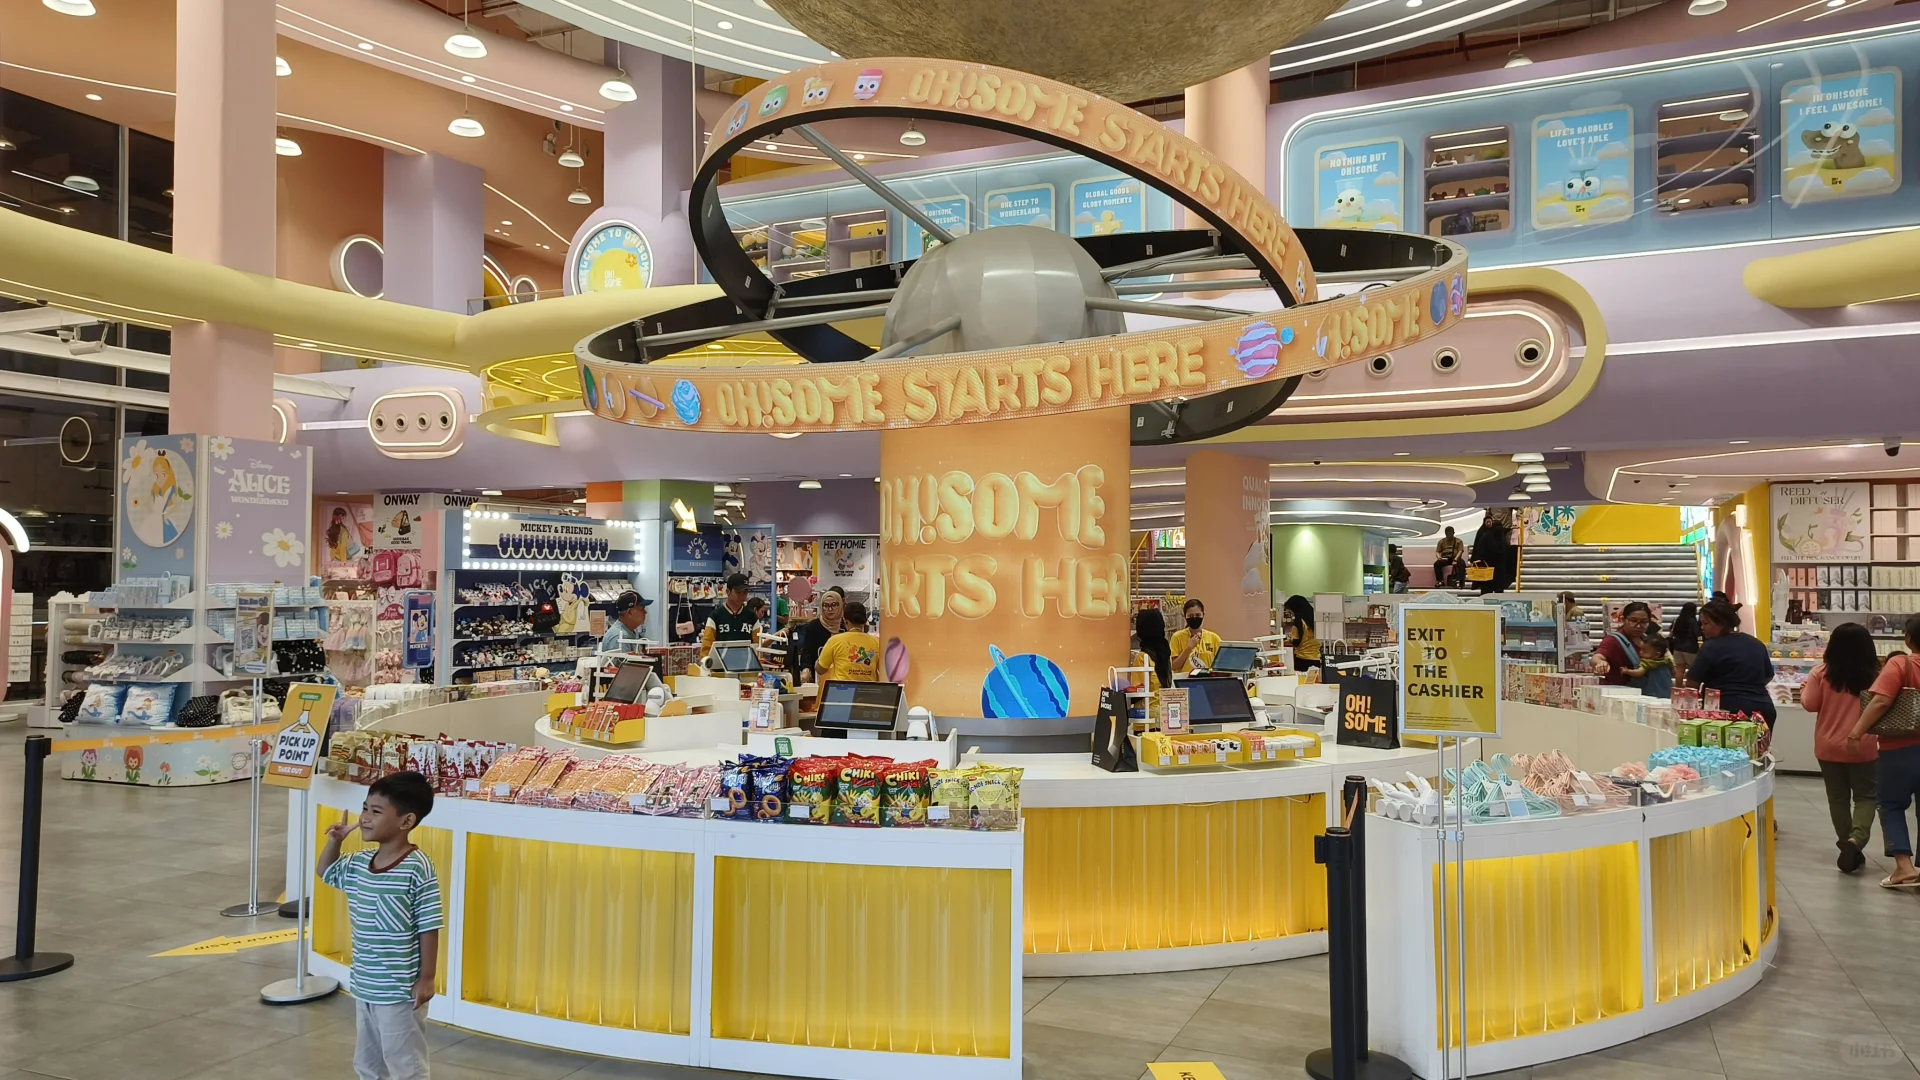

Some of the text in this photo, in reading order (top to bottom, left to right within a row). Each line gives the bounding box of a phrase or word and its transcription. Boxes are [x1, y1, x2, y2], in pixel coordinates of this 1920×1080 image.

[1813, 88, 1868, 102] IN OH!SOME
[1806, 105, 1828, 115] FEEL
[1832, 98, 1882, 112] AWESOME!
[1550, 128, 1574, 138] LIFE'S
[1557, 134, 1608, 147] LOVE'S ABLE
[1329, 152, 1387, 168] NOTHING BUT
[907, 68, 1290, 271] OH!SOME STARTS HERE
[1341, 164, 1378, 176] OH!SOME
[1110, 187, 1129, 195] GOODS
[1014, 199, 1029, 207] STEP
[1103, 197, 1132, 206] MOMENTS
[1000, 207, 1040, 218] WONDERLAND
[579, 233, 606, 287] WELCOME
[609, 228, 622, 239] TO
[716, 338, 1207, 428] OH!SOME STARTS HERE
[228, 468, 291, 495] ALICE
[1780, 486, 1811, 496] REED
[231, 496, 289, 506] WONDERLAND
[383, 494, 421, 507] ONWAY
[443, 495, 479, 508] ONWAY
[881, 464, 1106, 550] OH!SOME
[1790, 496, 1845, 506] DIFFUSER
[520, 523, 553, 534] MICKEY
[561, 526, 593, 536] FRIENDS
[687, 537, 709, 559] MICKEY &
[823, 539, 866, 549] HEY HOMIE
[719, 623, 730, 633] 53
[1407, 628, 1445, 641] EXIT
[1424, 646, 1448, 660] TO
[1413, 664, 1448, 678] THE
[1407, 683, 1484, 699] CASHIER
[1345, 694, 1371, 713] OH!
[1345, 712, 1387, 734] SOME
[279, 735, 315, 748] PICK UP
[279, 749, 309, 762] POINT
[793, 772, 825, 784] CHIKI
[840, 767, 875, 782] CHIKI
[885, 771, 920, 786] CHIKI
